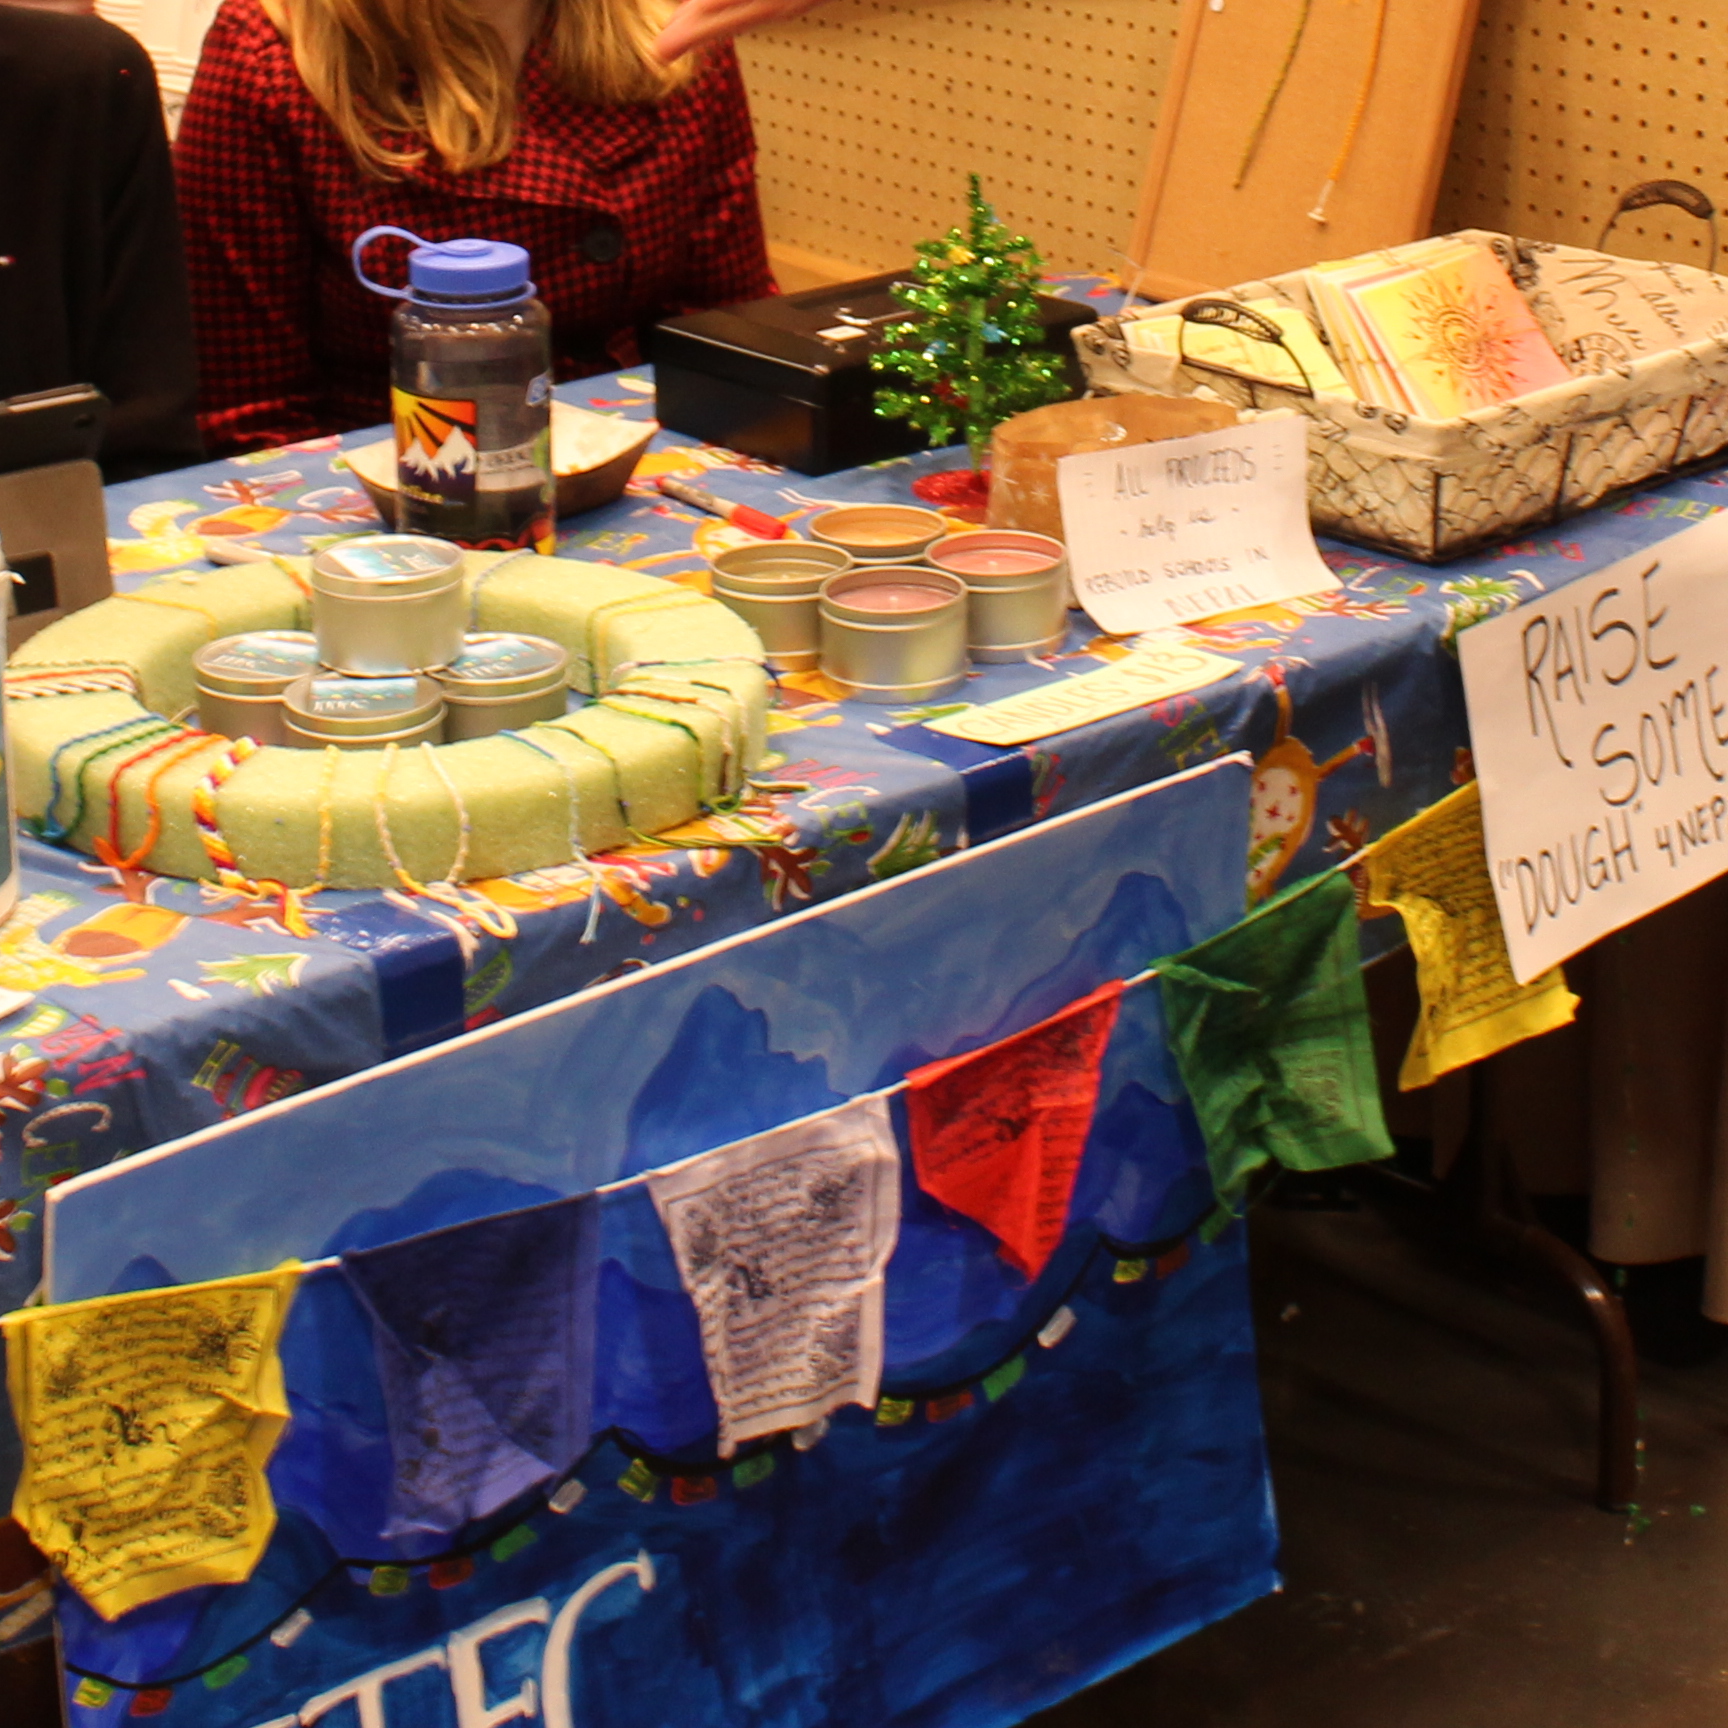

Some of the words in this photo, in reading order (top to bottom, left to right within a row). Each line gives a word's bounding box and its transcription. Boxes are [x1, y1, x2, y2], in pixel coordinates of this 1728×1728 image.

[1163, 583, 1266, 619] NEPAL
[1521, 560, 1679, 769] RAISE
[252, 1549, 658, 1728] TFC
